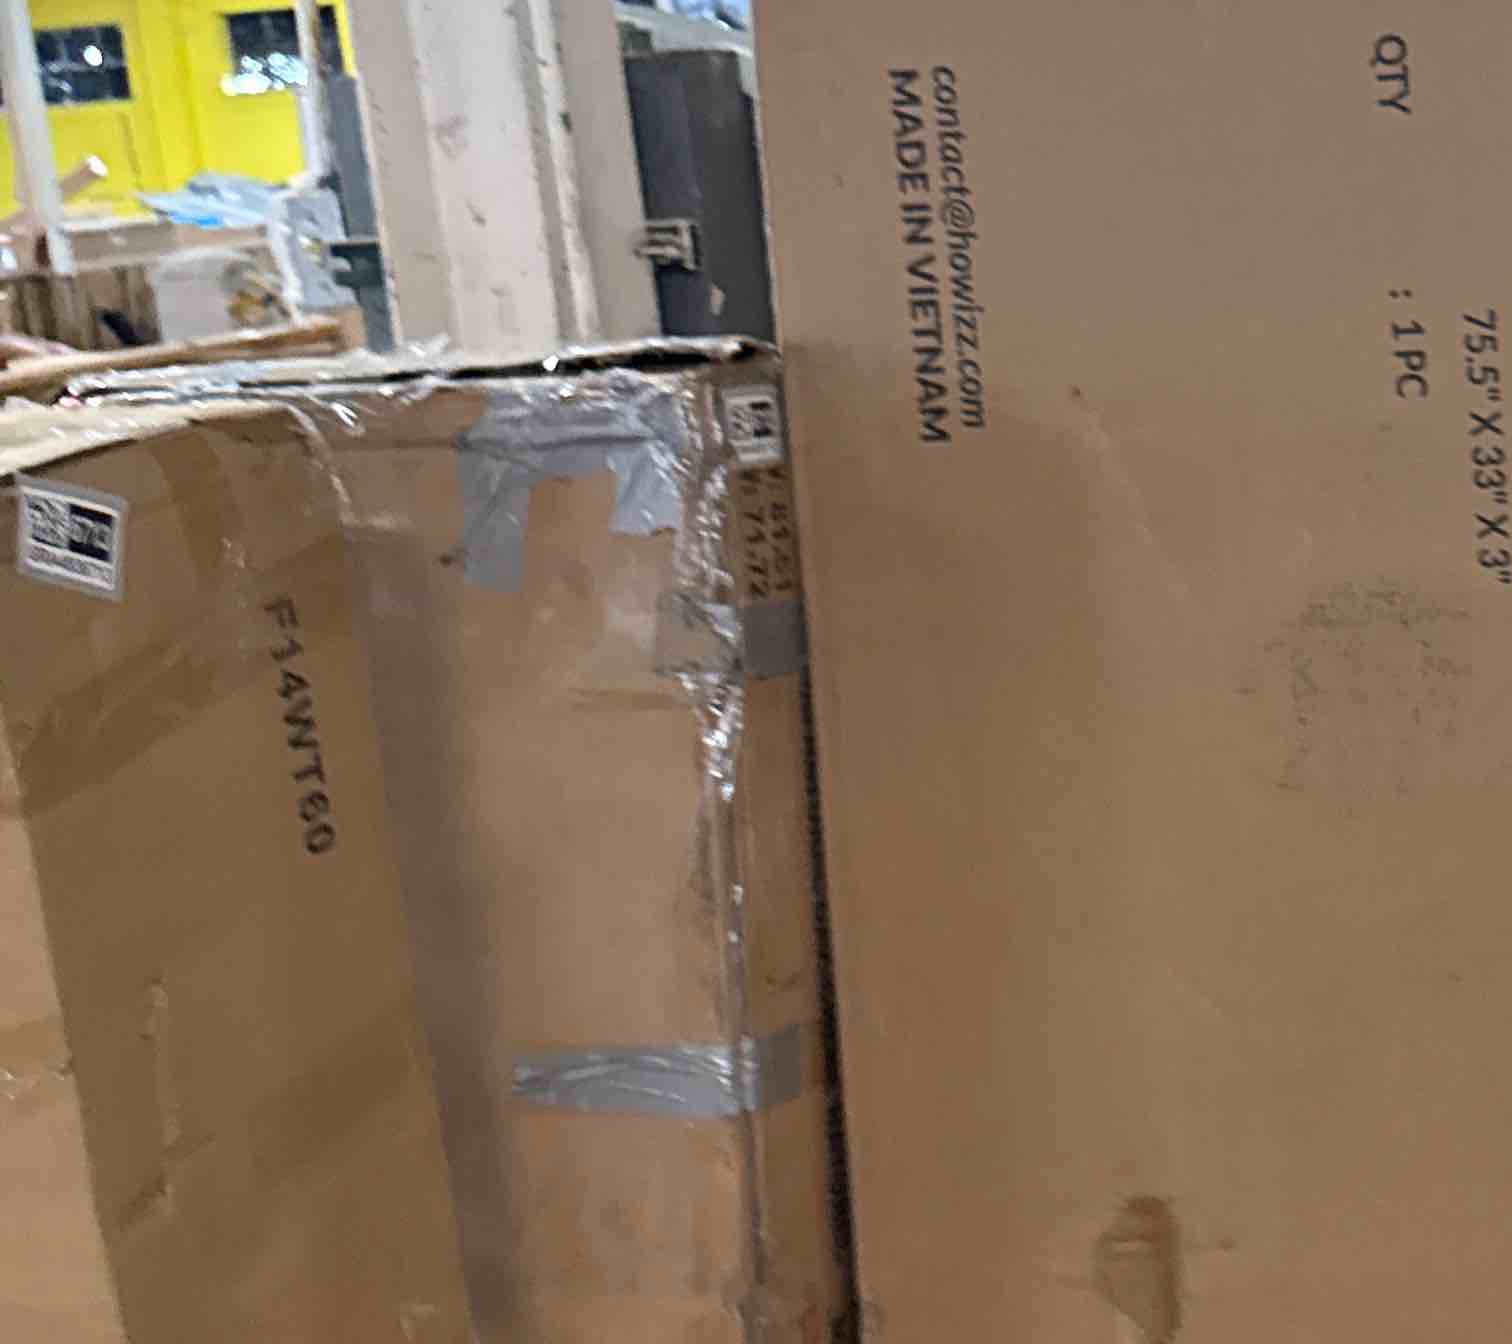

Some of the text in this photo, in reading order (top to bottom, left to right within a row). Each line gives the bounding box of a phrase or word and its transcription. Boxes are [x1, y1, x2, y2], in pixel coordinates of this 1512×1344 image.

[1370, 33, 1411, 114] QTY
[889, 69, 951, 444] MADE IN VIETNAM
[933, 65, 986, 430] contact@howizz.com
[1392, 320, 1424, 338] 1
[1463, 309, 1501, 401] 75.5"
[1394, 350, 1428, 399] PC
[1469, 413, 1504, 435] X
[1470, 447, 1507, 504] 33"
[1475, 513, 1511, 537] X
